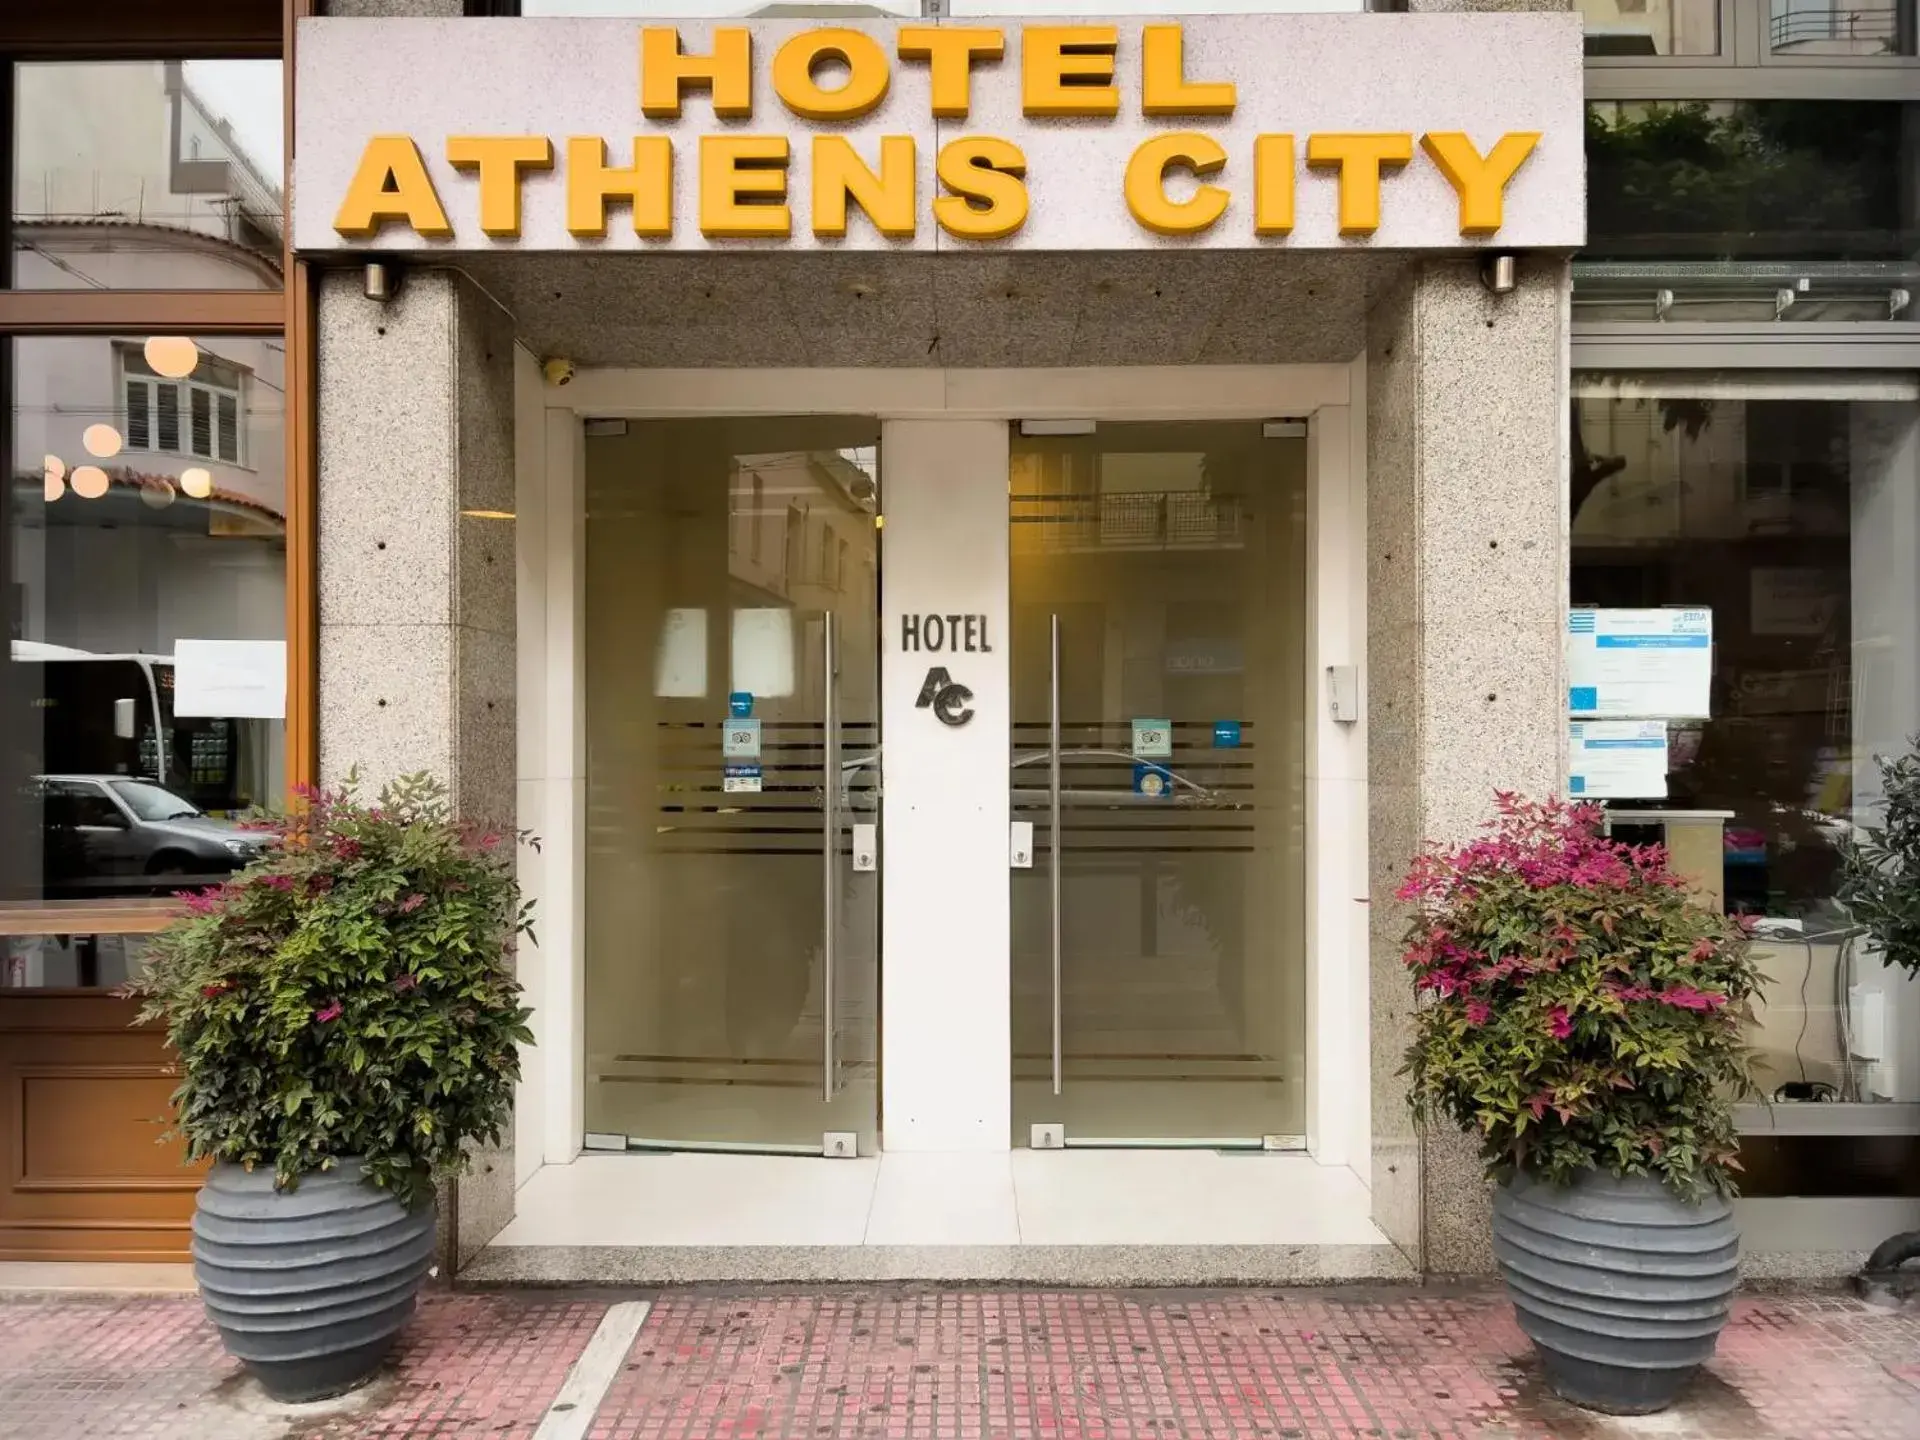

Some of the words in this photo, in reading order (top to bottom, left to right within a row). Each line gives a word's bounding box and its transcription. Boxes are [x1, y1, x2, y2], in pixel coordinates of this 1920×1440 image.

[640, 25, 1238, 120] HOTEL
[332, 134, 1030, 241] ATHENS
[1123, 130, 1544, 237] CITY
[902, 614, 992, 652] HOTEL
[915, 667, 975, 726] AC
